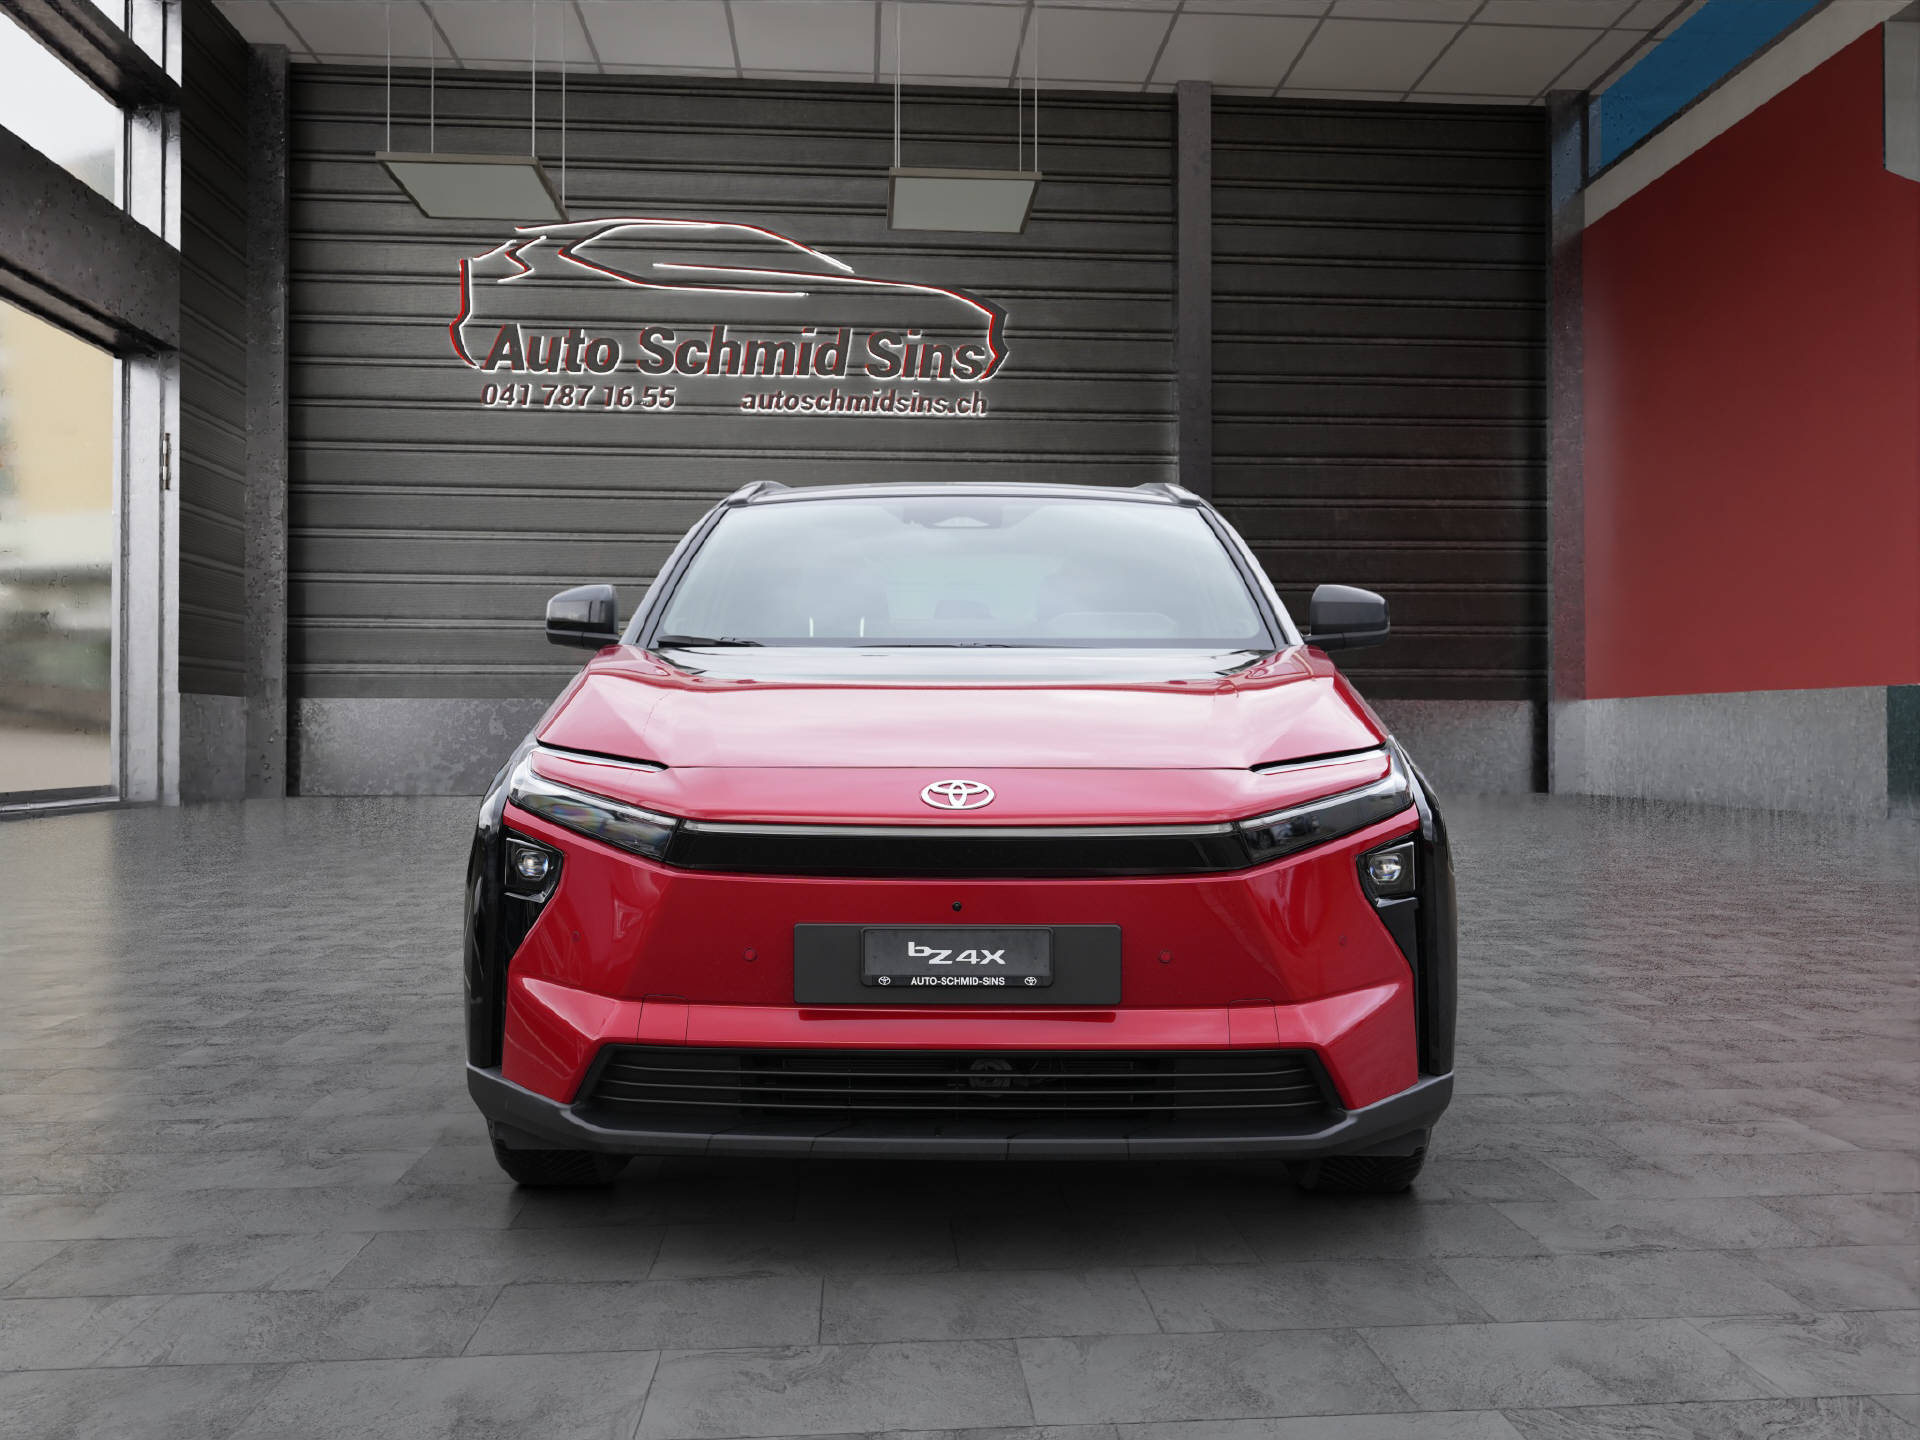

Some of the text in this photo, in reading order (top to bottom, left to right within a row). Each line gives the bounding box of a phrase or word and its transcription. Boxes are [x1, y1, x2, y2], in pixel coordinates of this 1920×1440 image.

[480, 323, 987, 382] Auto Schmid Sins
[481, 383, 677, 411] 041 787 16 55
[740, 388, 988, 417] autoschmidsins.ch
[910, 976, 1006, 986] AUTO-SCHMID-SINS
